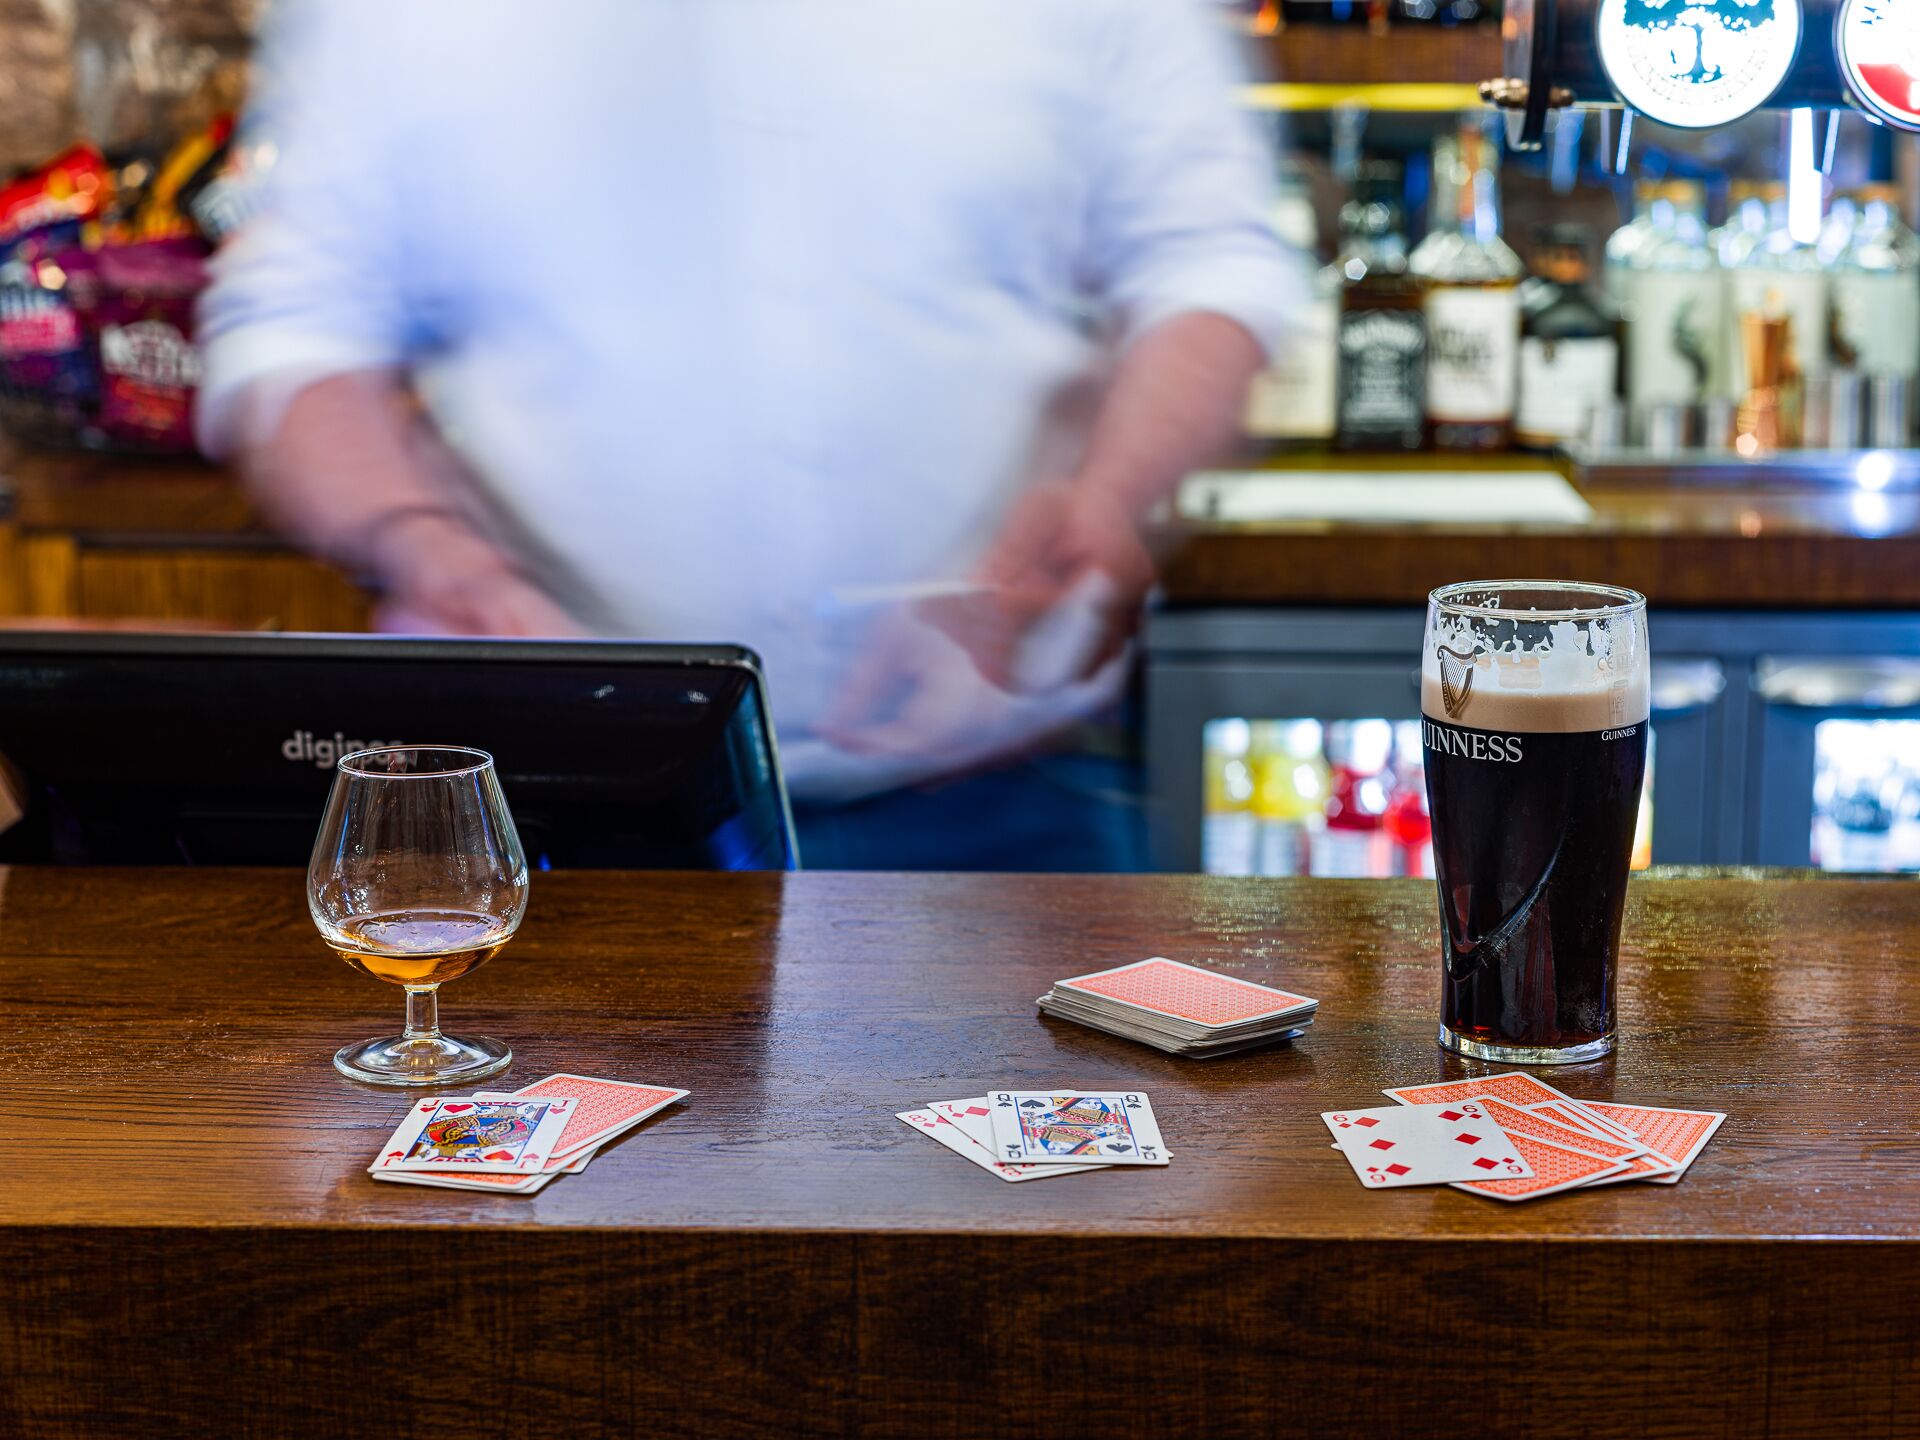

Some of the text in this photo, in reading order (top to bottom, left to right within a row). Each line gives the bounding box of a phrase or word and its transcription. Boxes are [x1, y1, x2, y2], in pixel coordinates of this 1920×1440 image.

[1601, 726, 1637, 741] GUINNESS
[1421, 715, 1523, 763] UINNESS
[996, 1093, 1012, 1102] Q
[1125, 1094, 1141, 1103] Q
[423, 1099, 440, 1107] J
[553, 1099, 571, 1107] J
[940, 1104, 954, 1113] 7
[1462, 1104, 1478, 1113] 6
[908, 1114, 926, 1123] 8
[1333, 1114, 1347, 1122] 6
